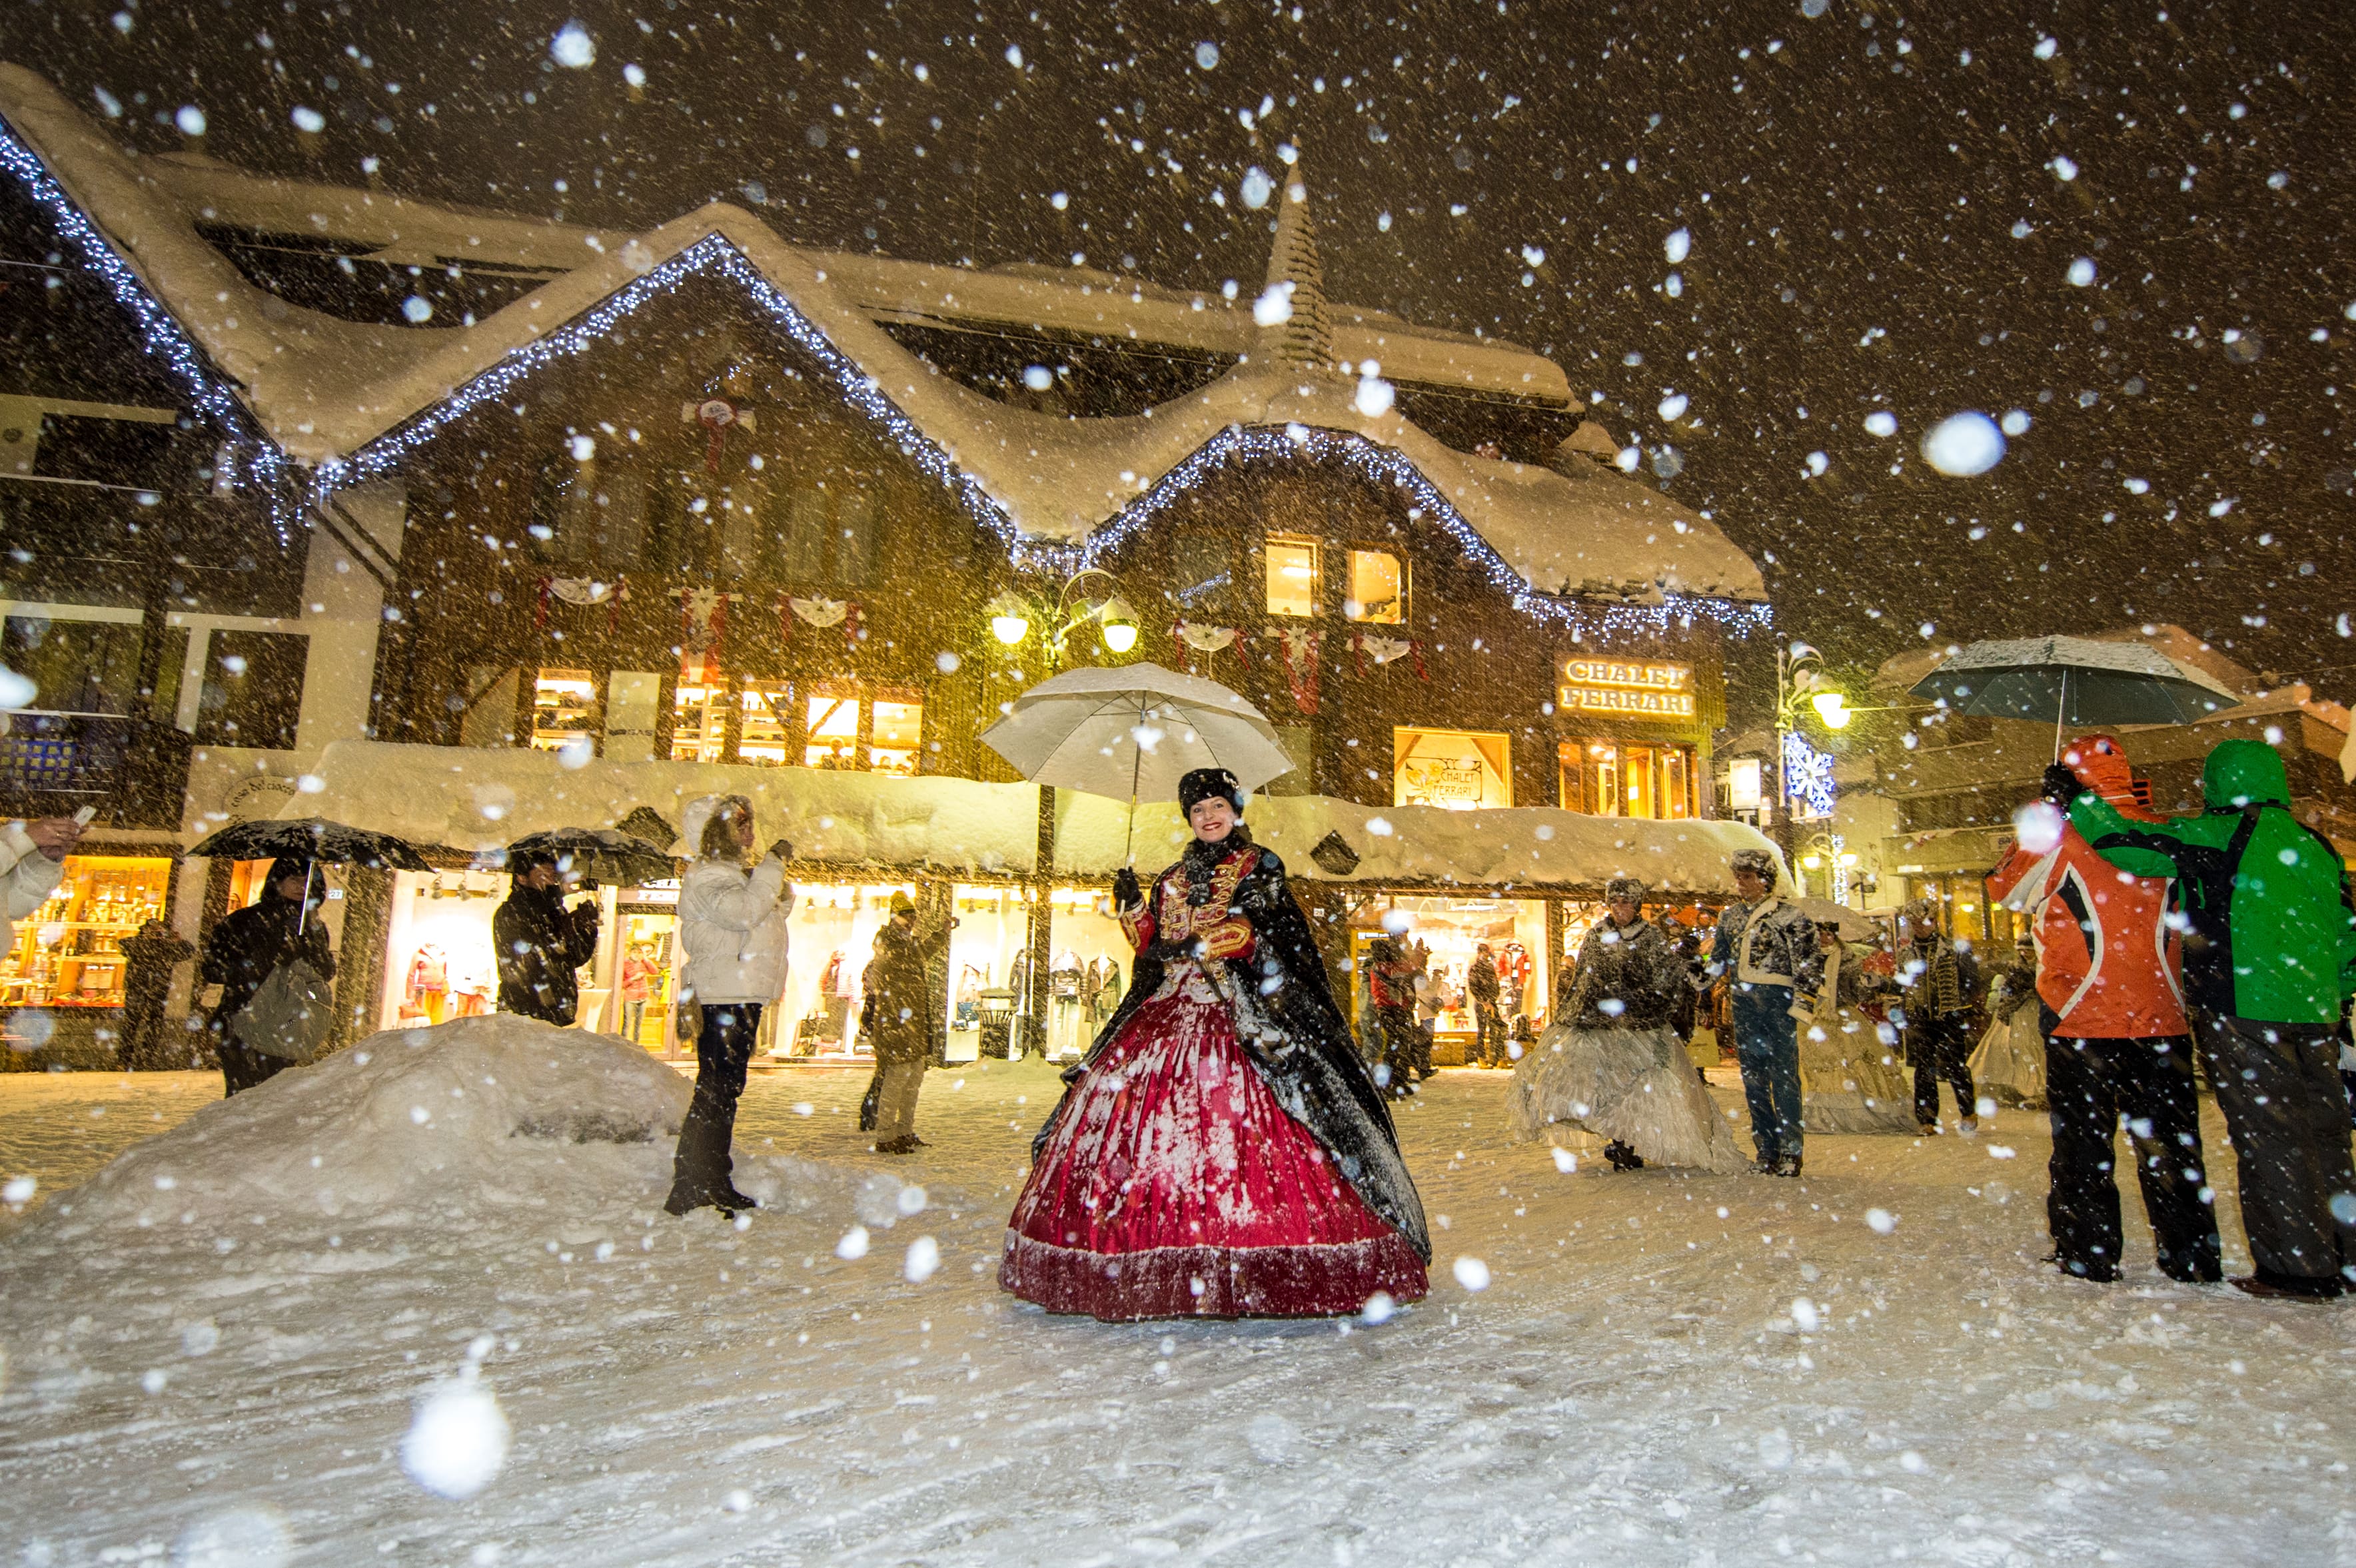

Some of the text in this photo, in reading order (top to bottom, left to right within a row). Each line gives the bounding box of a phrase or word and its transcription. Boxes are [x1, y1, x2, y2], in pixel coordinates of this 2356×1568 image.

[1568, 661, 1686, 687] CHALET
[1562, 687, 1694, 713] FERRARI
[1441, 771, 1475, 783] CHALET
[1433, 785, 1472, 797] FERRARI
[642, 878, 682, 889] CHA
